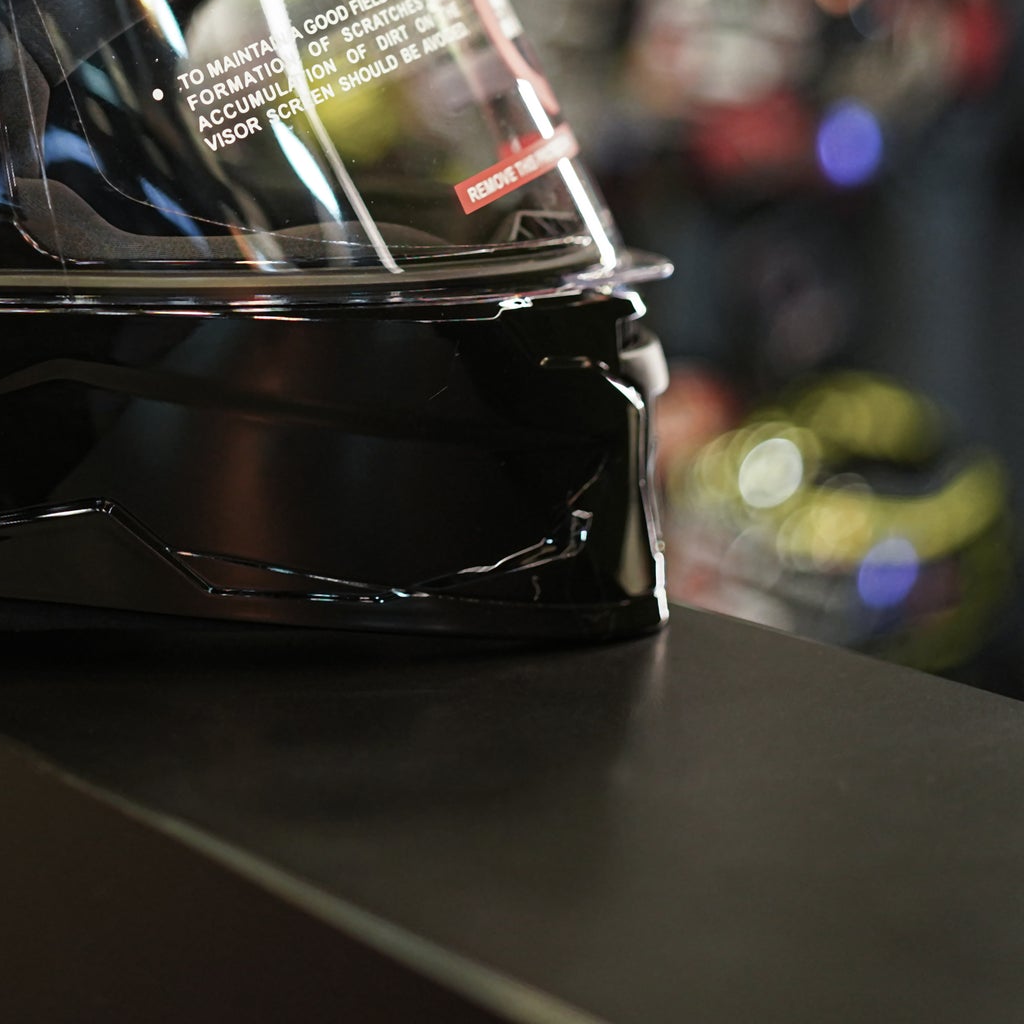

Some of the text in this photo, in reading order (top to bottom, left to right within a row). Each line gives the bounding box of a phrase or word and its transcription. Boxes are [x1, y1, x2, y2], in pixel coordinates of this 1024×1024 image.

[177, 69, 204, 90] TO
[206, 28, 287, 79] MAINTAI
[289, 25, 304, 40] A
[303, 5, 349, 35] GOOD
[186, 49, 297, 112] FORMATIO
[308, 35, 330, 57] OF
[198, 58, 337, 133] ACCUMULAION
[346, 43, 367, 64] OF
[375, 23, 409, 51] DIRT
[414, 13, 435, 34] ON
[203, 116, 263, 152] VISOR
[266, 83, 336, 124] SCREN
[338, 54, 399, 92] SHOULD
[399, 43, 422, 64] BE
[466, 165, 518, 204] REMOVE
